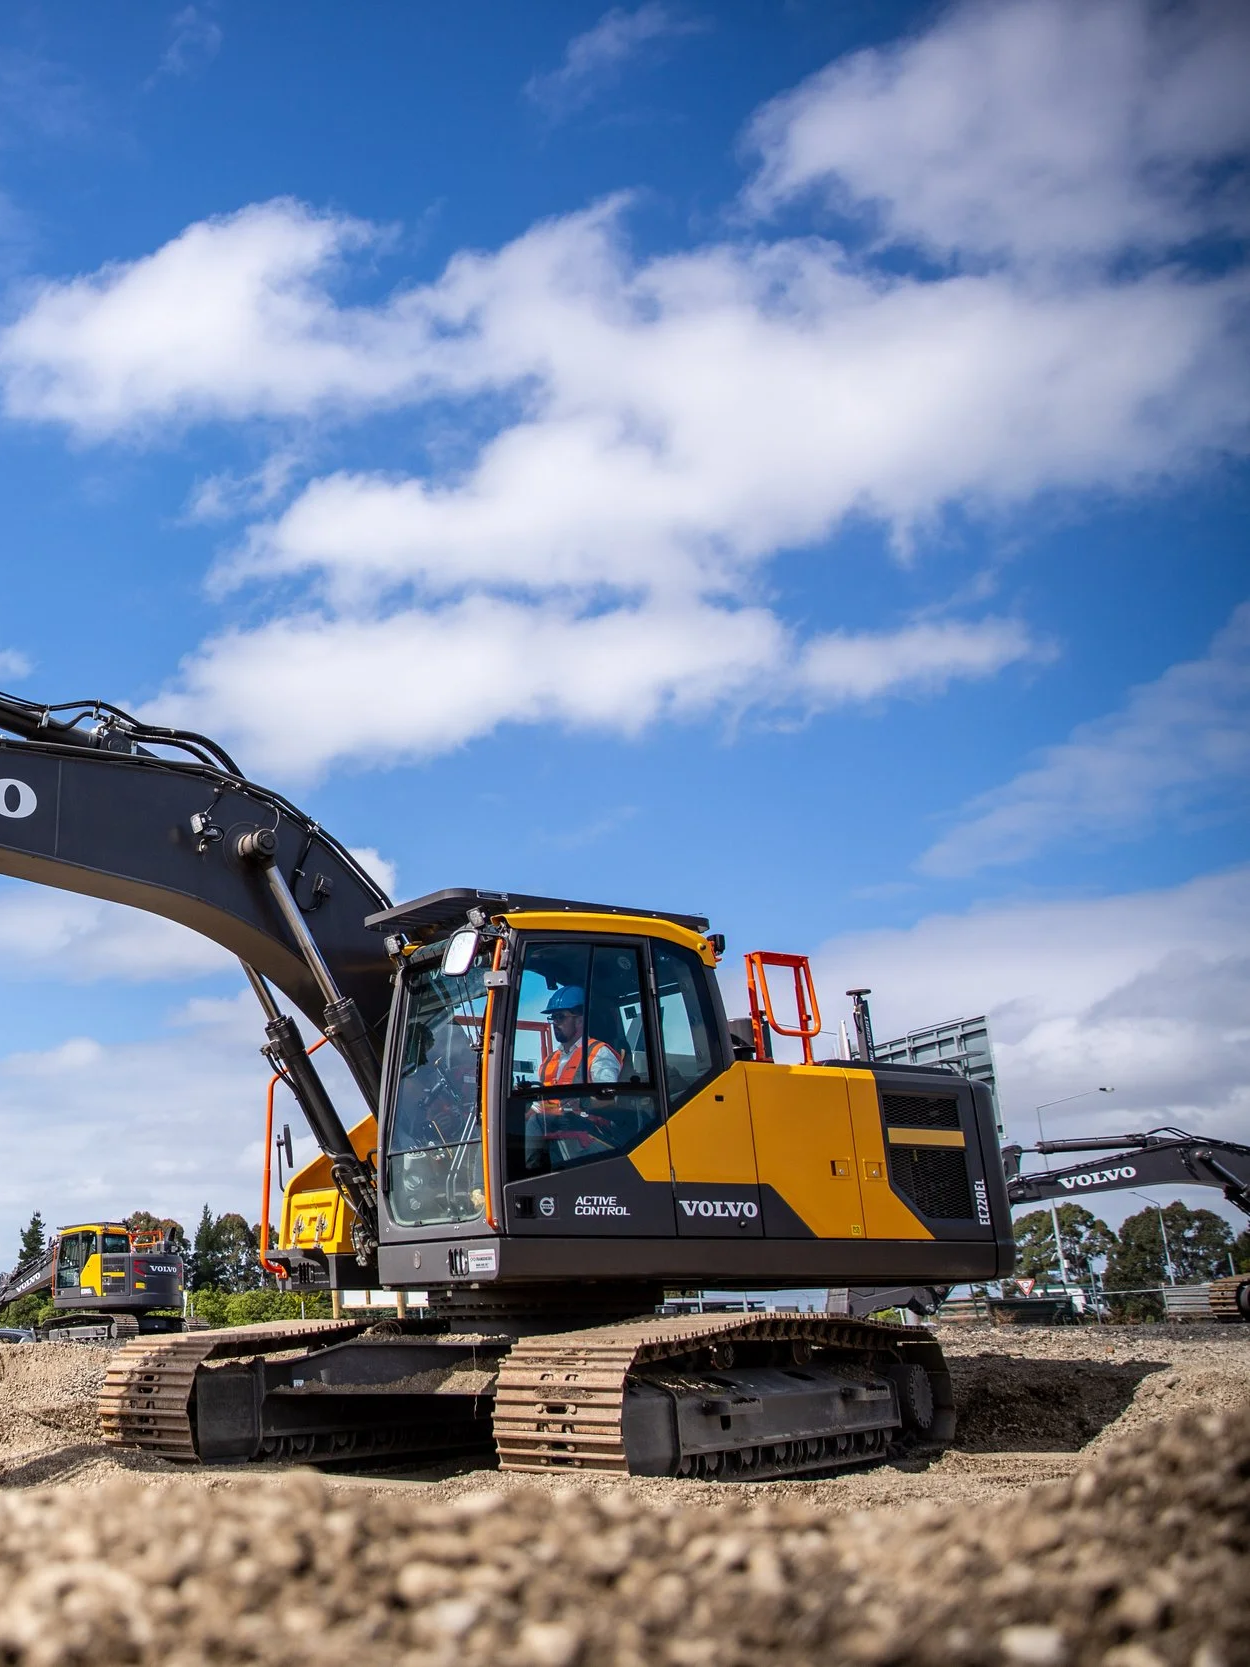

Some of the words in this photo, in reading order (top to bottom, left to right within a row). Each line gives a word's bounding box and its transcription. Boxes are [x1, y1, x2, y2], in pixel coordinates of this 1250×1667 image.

[1057, 1166, 1137, 1189] VOLVO
[575, 1196, 617, 1206] ACTIVE
[679, 1200, 758, 1218] VOLVO
[974, 1179, 990, 1225] EC220EL
[574, 1206, 631, 1216] CONTROL
[151, 1265, 177, 1274] VOLVO
[16, 1272, 41, 1293] VOLVO
